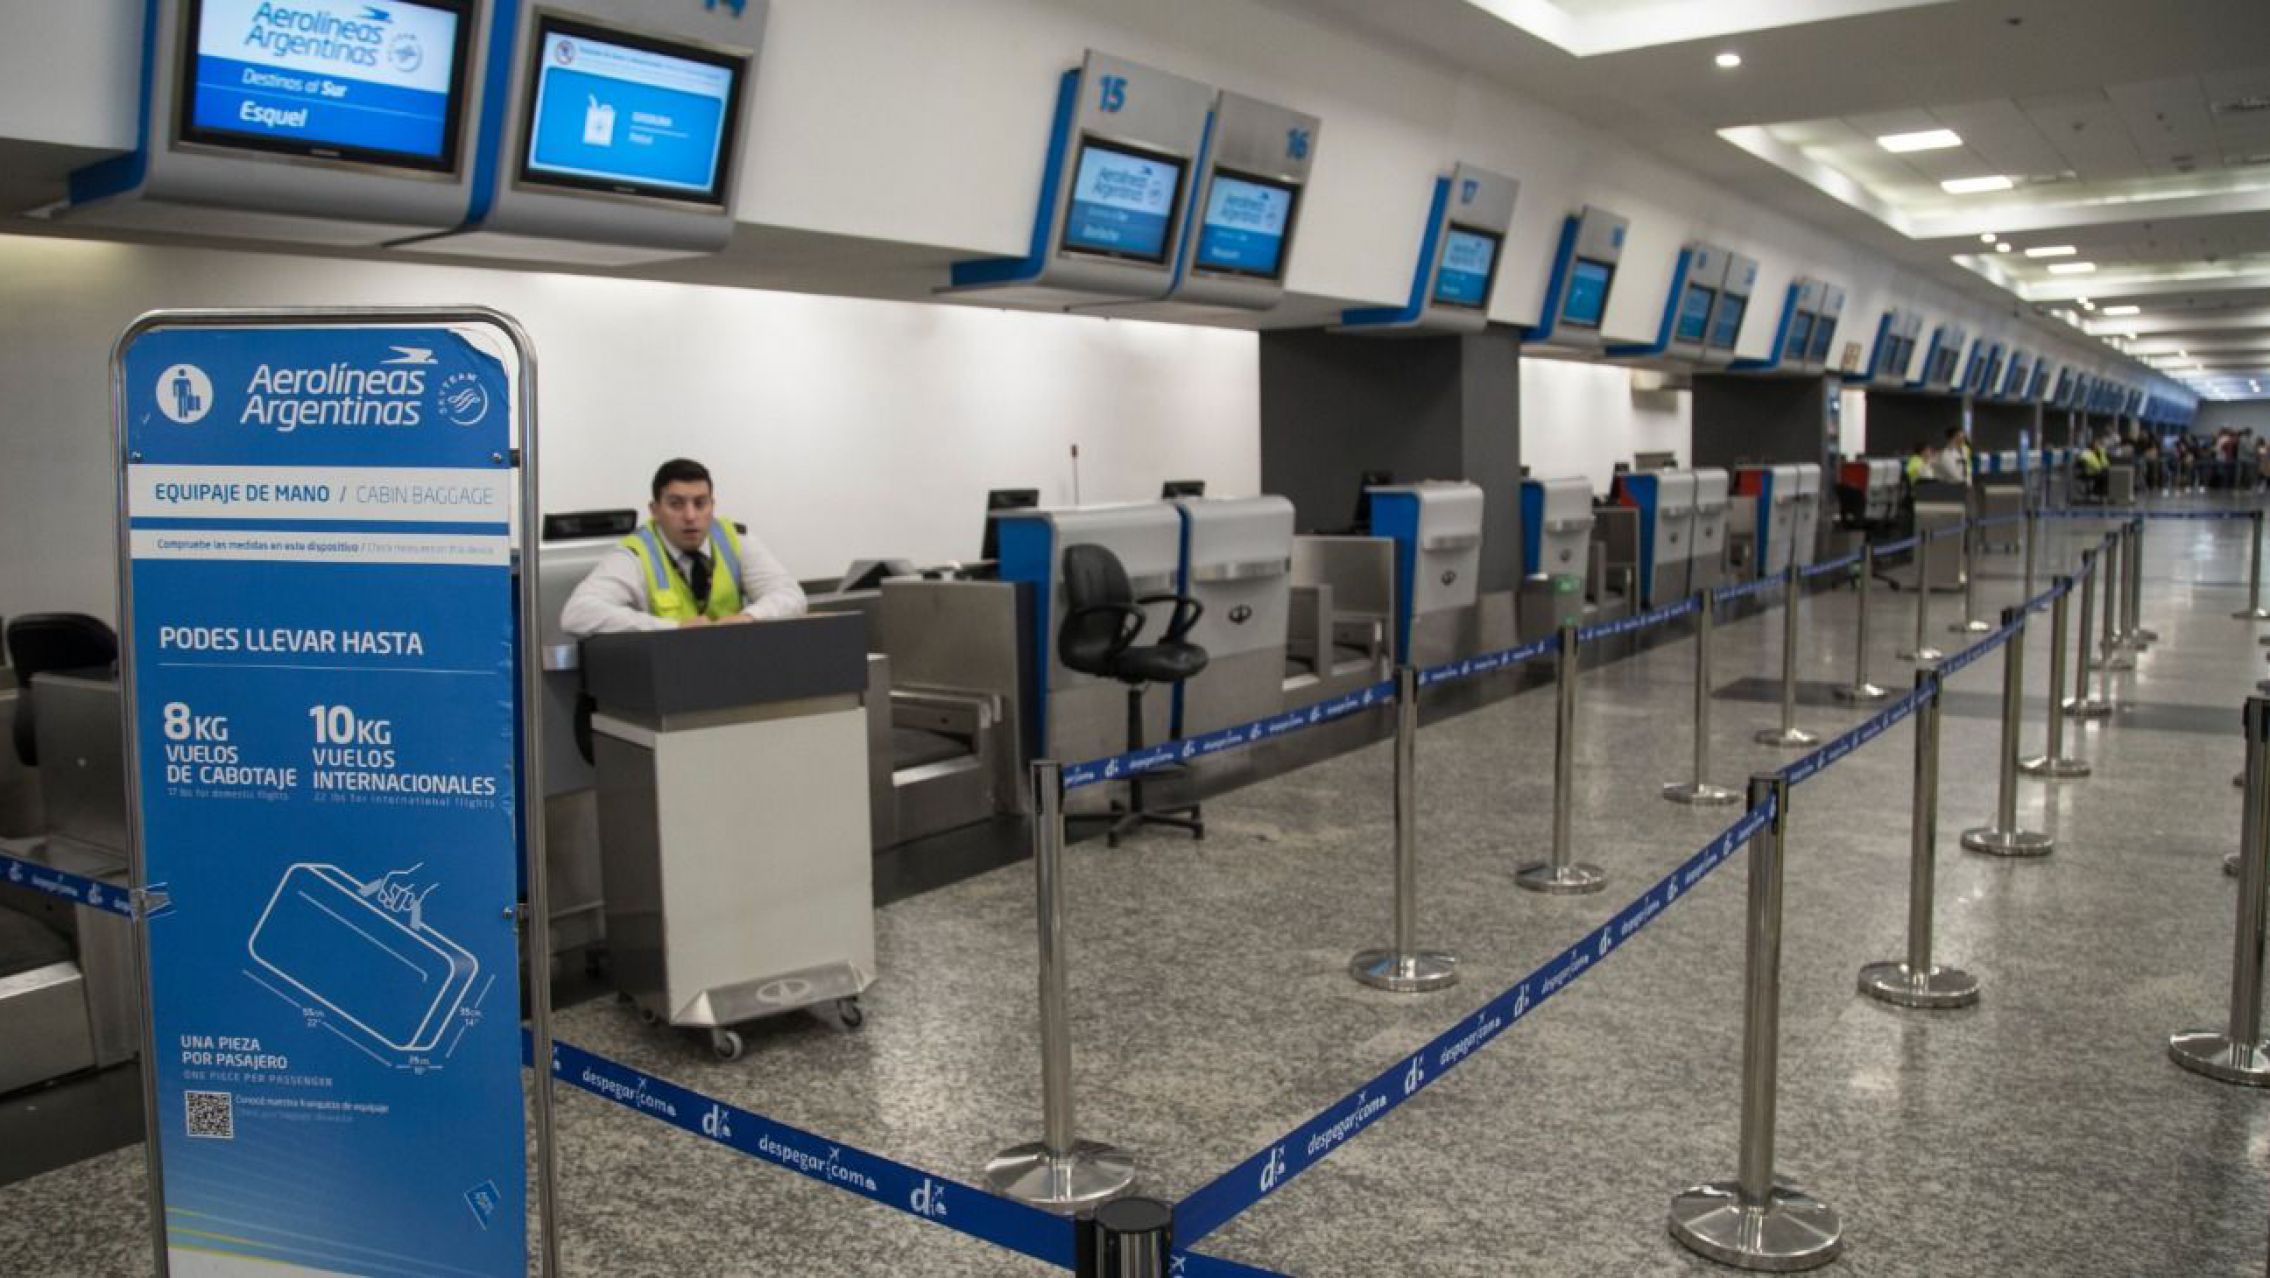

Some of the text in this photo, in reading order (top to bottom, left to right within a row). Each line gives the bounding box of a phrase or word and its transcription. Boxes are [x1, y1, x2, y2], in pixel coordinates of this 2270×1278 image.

[243, 24, 377, 67] Argentinas
[241, 67, 348, 98] Destinos al Sur
[1099, 75, 1128, 113] 15
[239, 100, 309, 128] Esquel
[1287, 127, 1310, 160] 16
[1461, 179, 1480, 205] 17
[247, 361, 426, 397] Aerolíneas
[240, 396, 421, 433] Argentinas
[155, 483, 240, 505] EQUIPAJE
[246, 484, 269, 502] DE
[275, 485, 330, 503] MANO
[356, 486, 408, 504] CABIN
[412, 486, 494, 506] BAGGAGE
[213, 539, 227, 550] las
[229, 540, 269, 551] medidas
[270, 543, 283, 551] en
[285, 541, 306, 552] este
[307, 540, 358, 554] dispositivo
[160, 626, 424, 656] PODES LLEVAR HASTA
[165, 744, 239, 764] VUELOS
[312, 747, 396, 768] VUELOS
[167, 764, 298, 791] DE CABOTAJE
[313, 770, 497, 796] INTERNACIONALES
[167, 787, 178, 796] 17
[195, 790, 209, 799] for
[211, 789, 255, 800] domestic
[257, 790, 289, 803] flights
[313, 793, 326, 803] 22
[330, 793, 346, 803] lbs
[370, 794, 450, 807] international
[454, 796, 496, 809] flights
[181, 1035, 261, 1051] UNA PIEZA
[182, 1051, 289, 1071] POR PASAJERO
[183, 1070, 334, 1088] ONE PIECE PER PASSENGER
